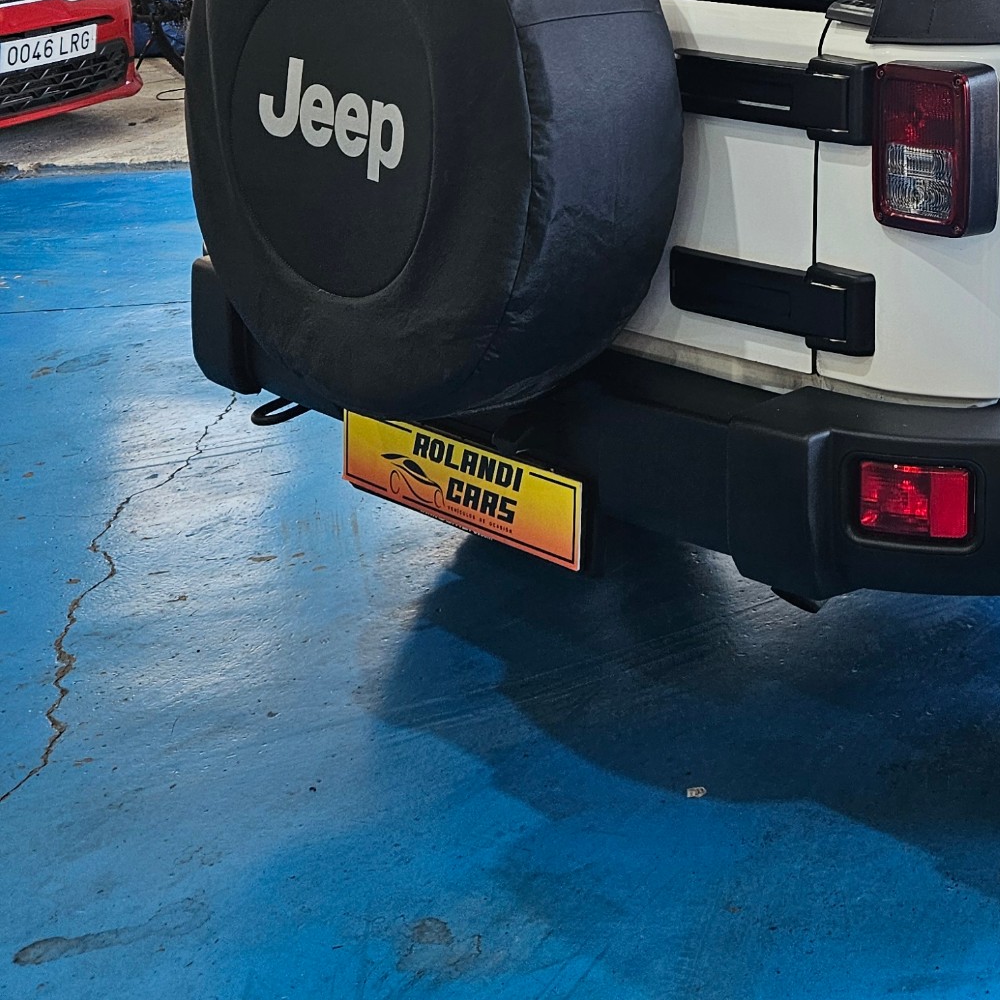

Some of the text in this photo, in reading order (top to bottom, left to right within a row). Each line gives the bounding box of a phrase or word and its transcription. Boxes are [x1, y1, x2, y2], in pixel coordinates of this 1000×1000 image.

[7, 31, 90, 66] 0046 LRG
[259, 56, 405, 183] Jeep
[413, 433, 524, 492] ROLANDI
[446, 477, 517, 524] CARS
